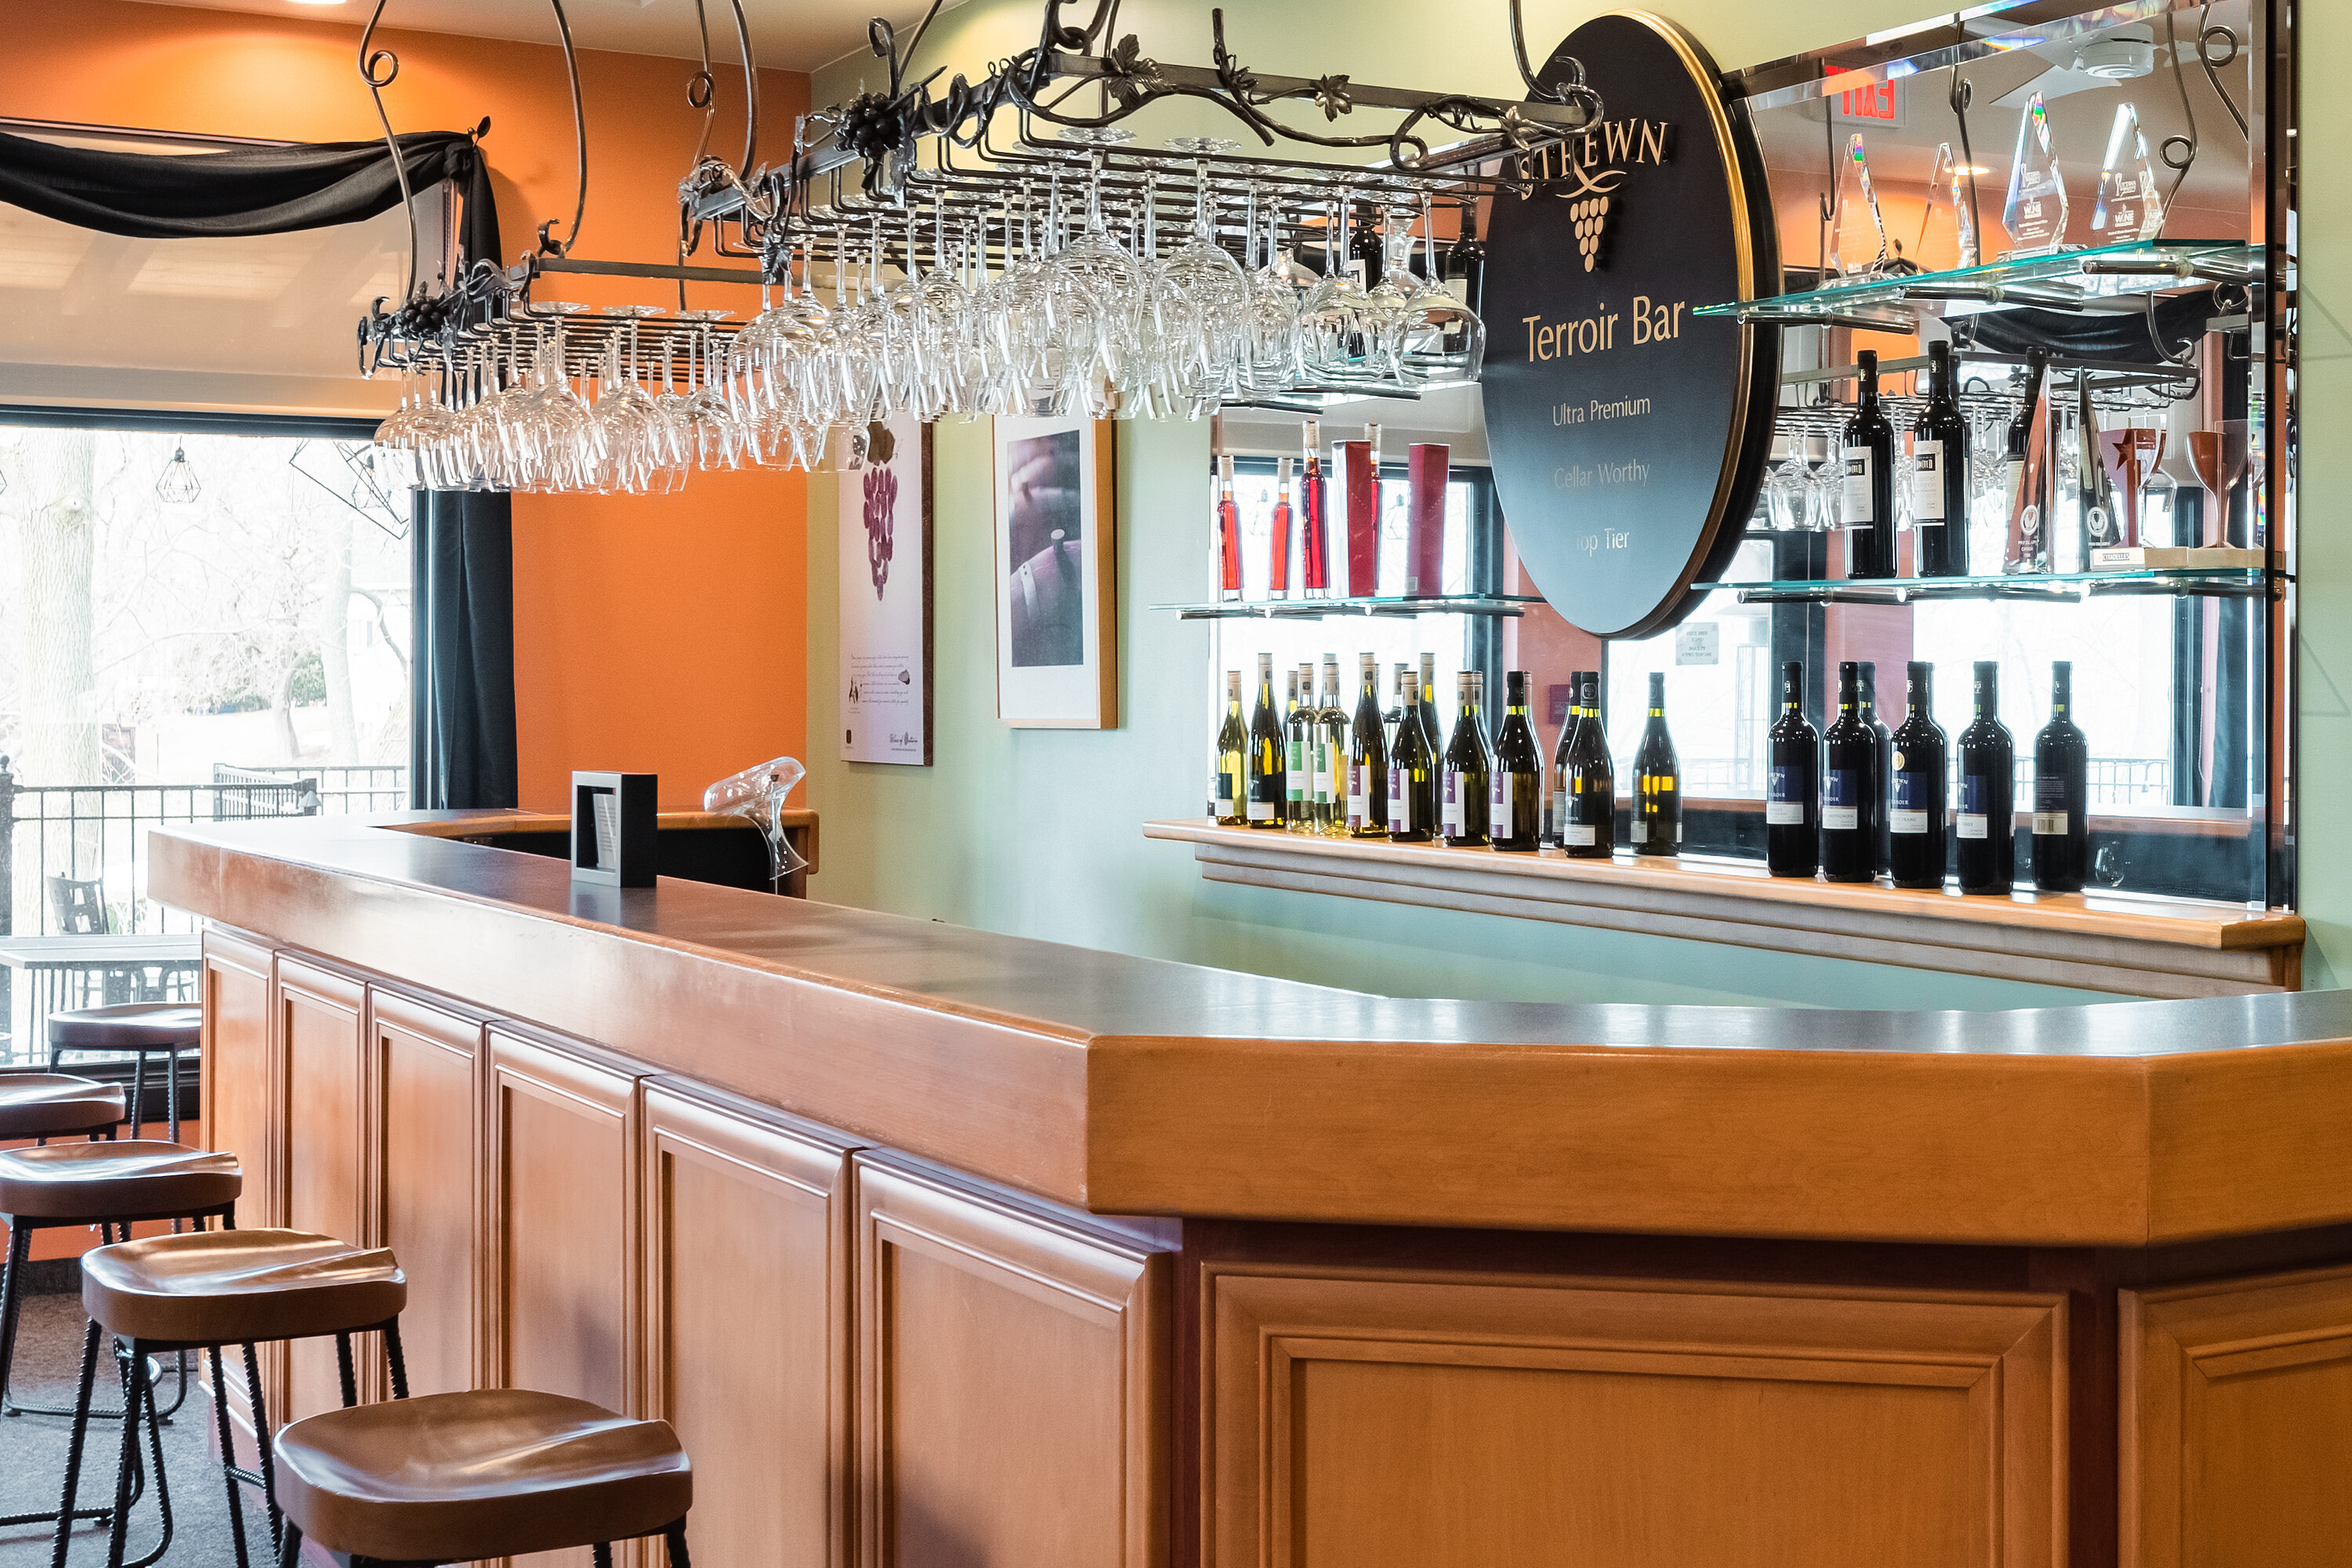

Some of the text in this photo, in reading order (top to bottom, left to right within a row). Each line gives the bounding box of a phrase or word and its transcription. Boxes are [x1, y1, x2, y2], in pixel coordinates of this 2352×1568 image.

[1523, 296, 1686, 362] Terroir Bar
[1553, 395, 1651, 426] Ultra Premium
[1555, 459, 1650, 489] Cellar Worthy
[1604, 528, 1630, 549] Tier
